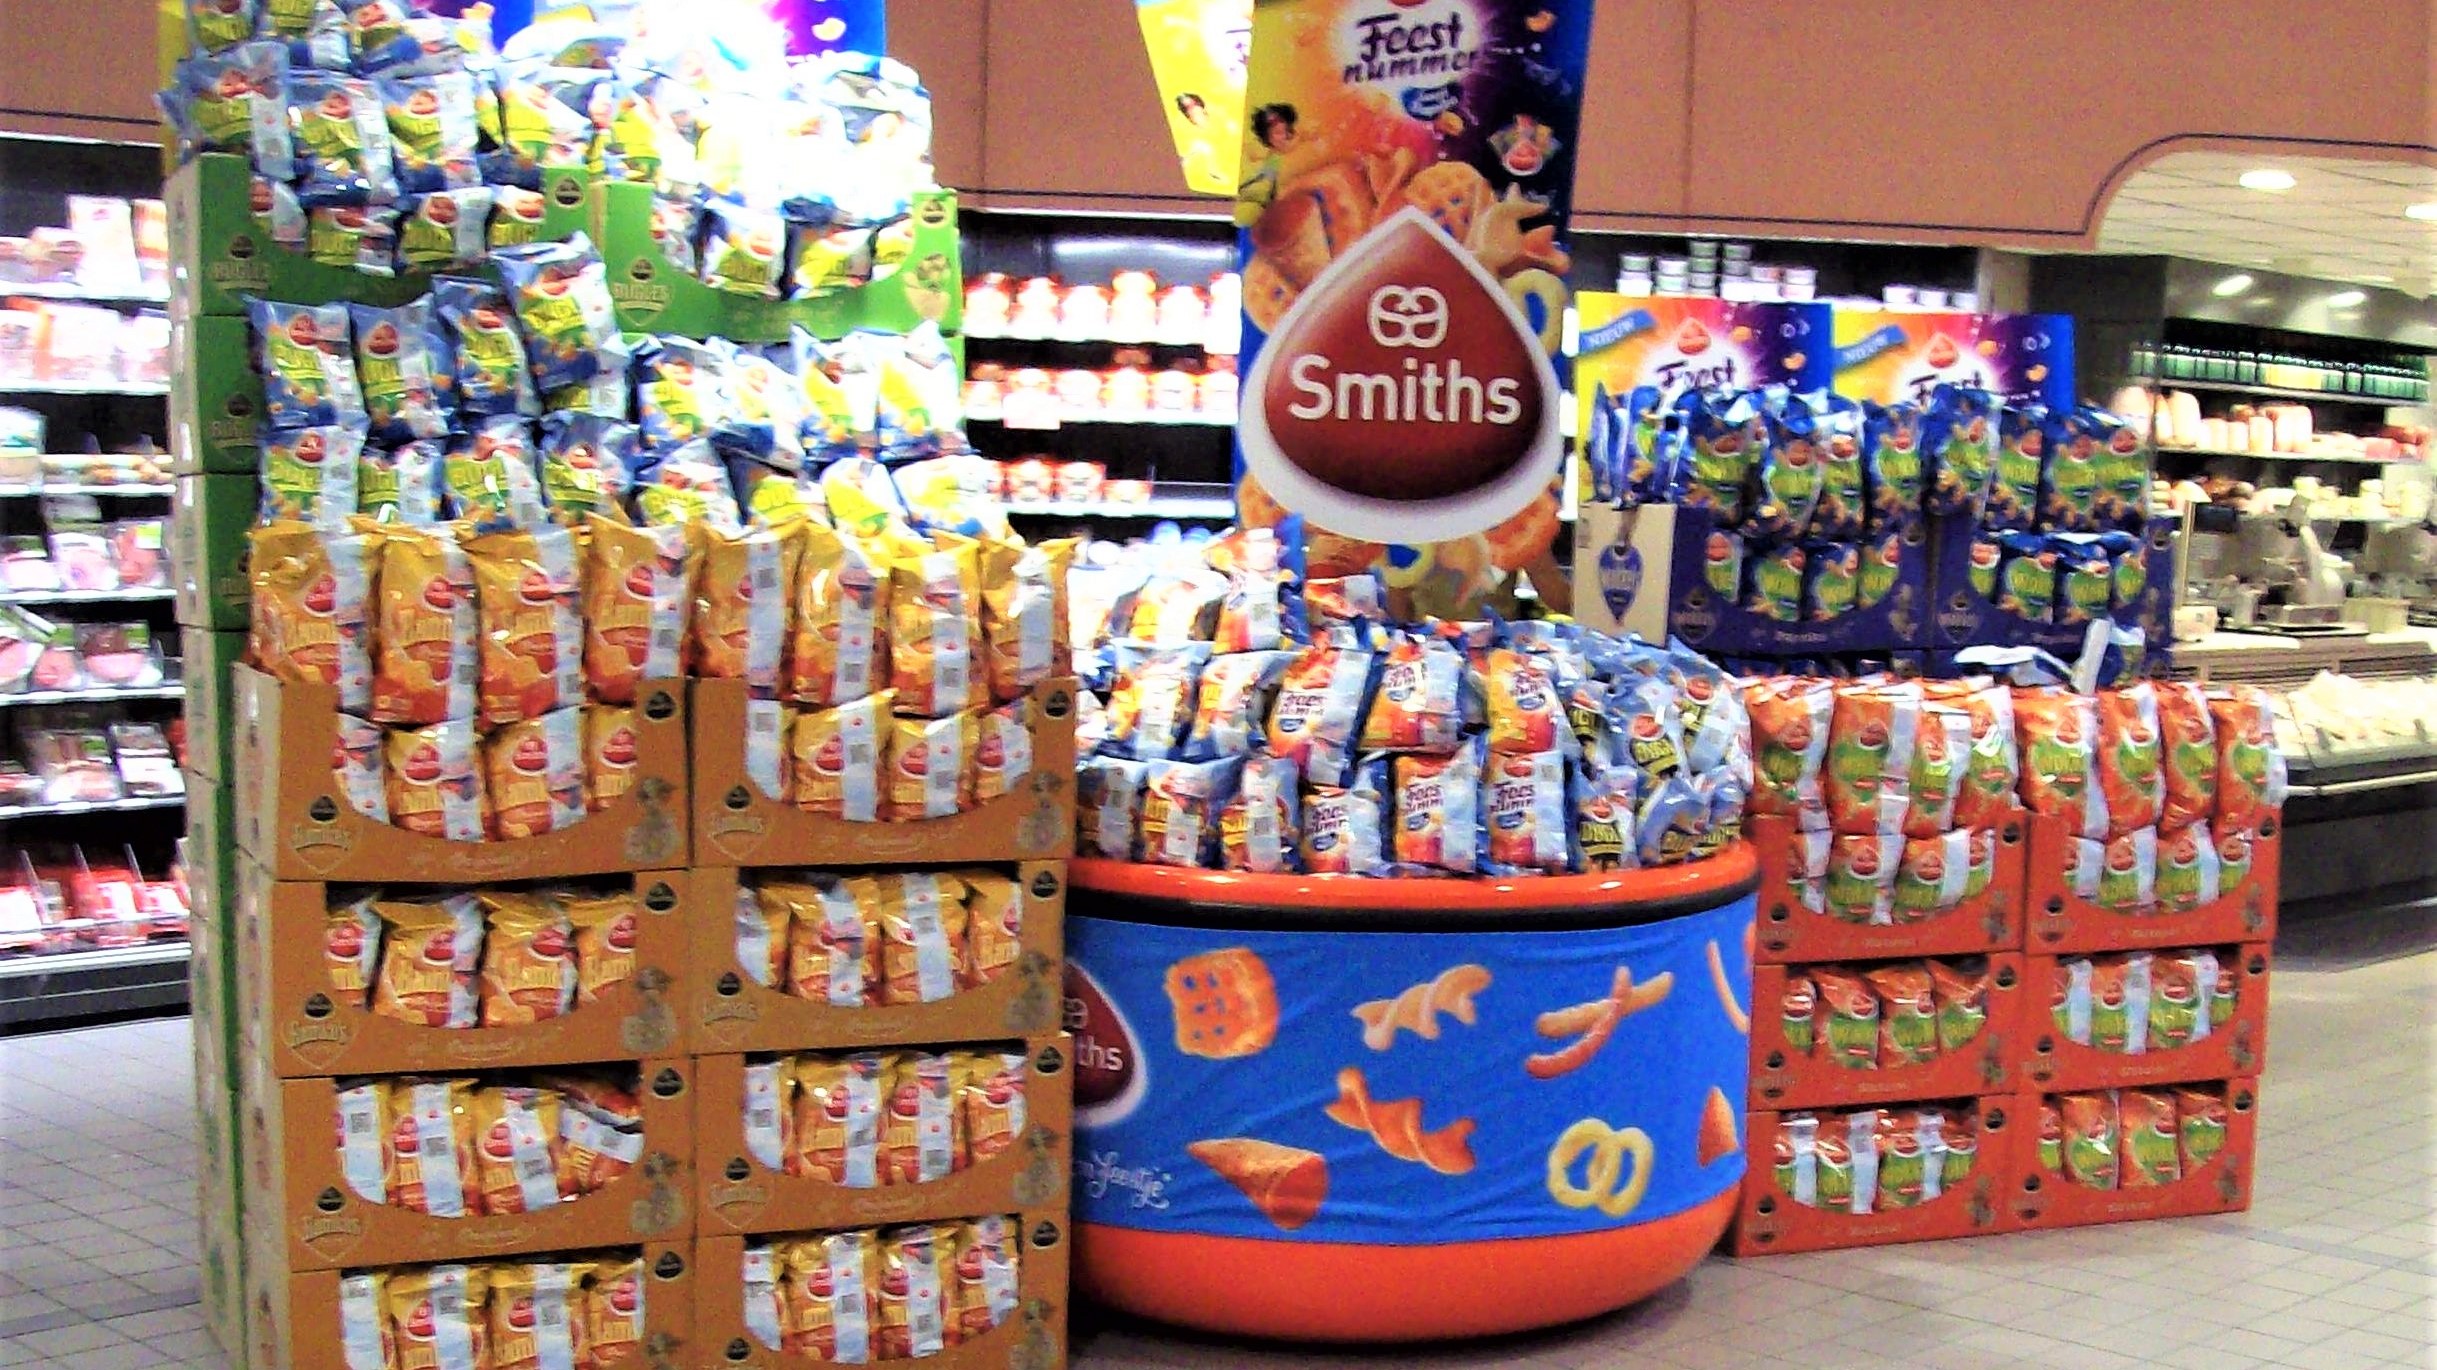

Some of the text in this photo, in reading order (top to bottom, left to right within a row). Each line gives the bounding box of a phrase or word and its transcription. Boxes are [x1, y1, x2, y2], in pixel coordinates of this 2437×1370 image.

[1357, 12, 1463, 63] Feest
[1342, 50, 1481, 85] nummer
[1288, 353, 1522, 426] Smiths
[1077, 1035, 1123, 1071] ths
